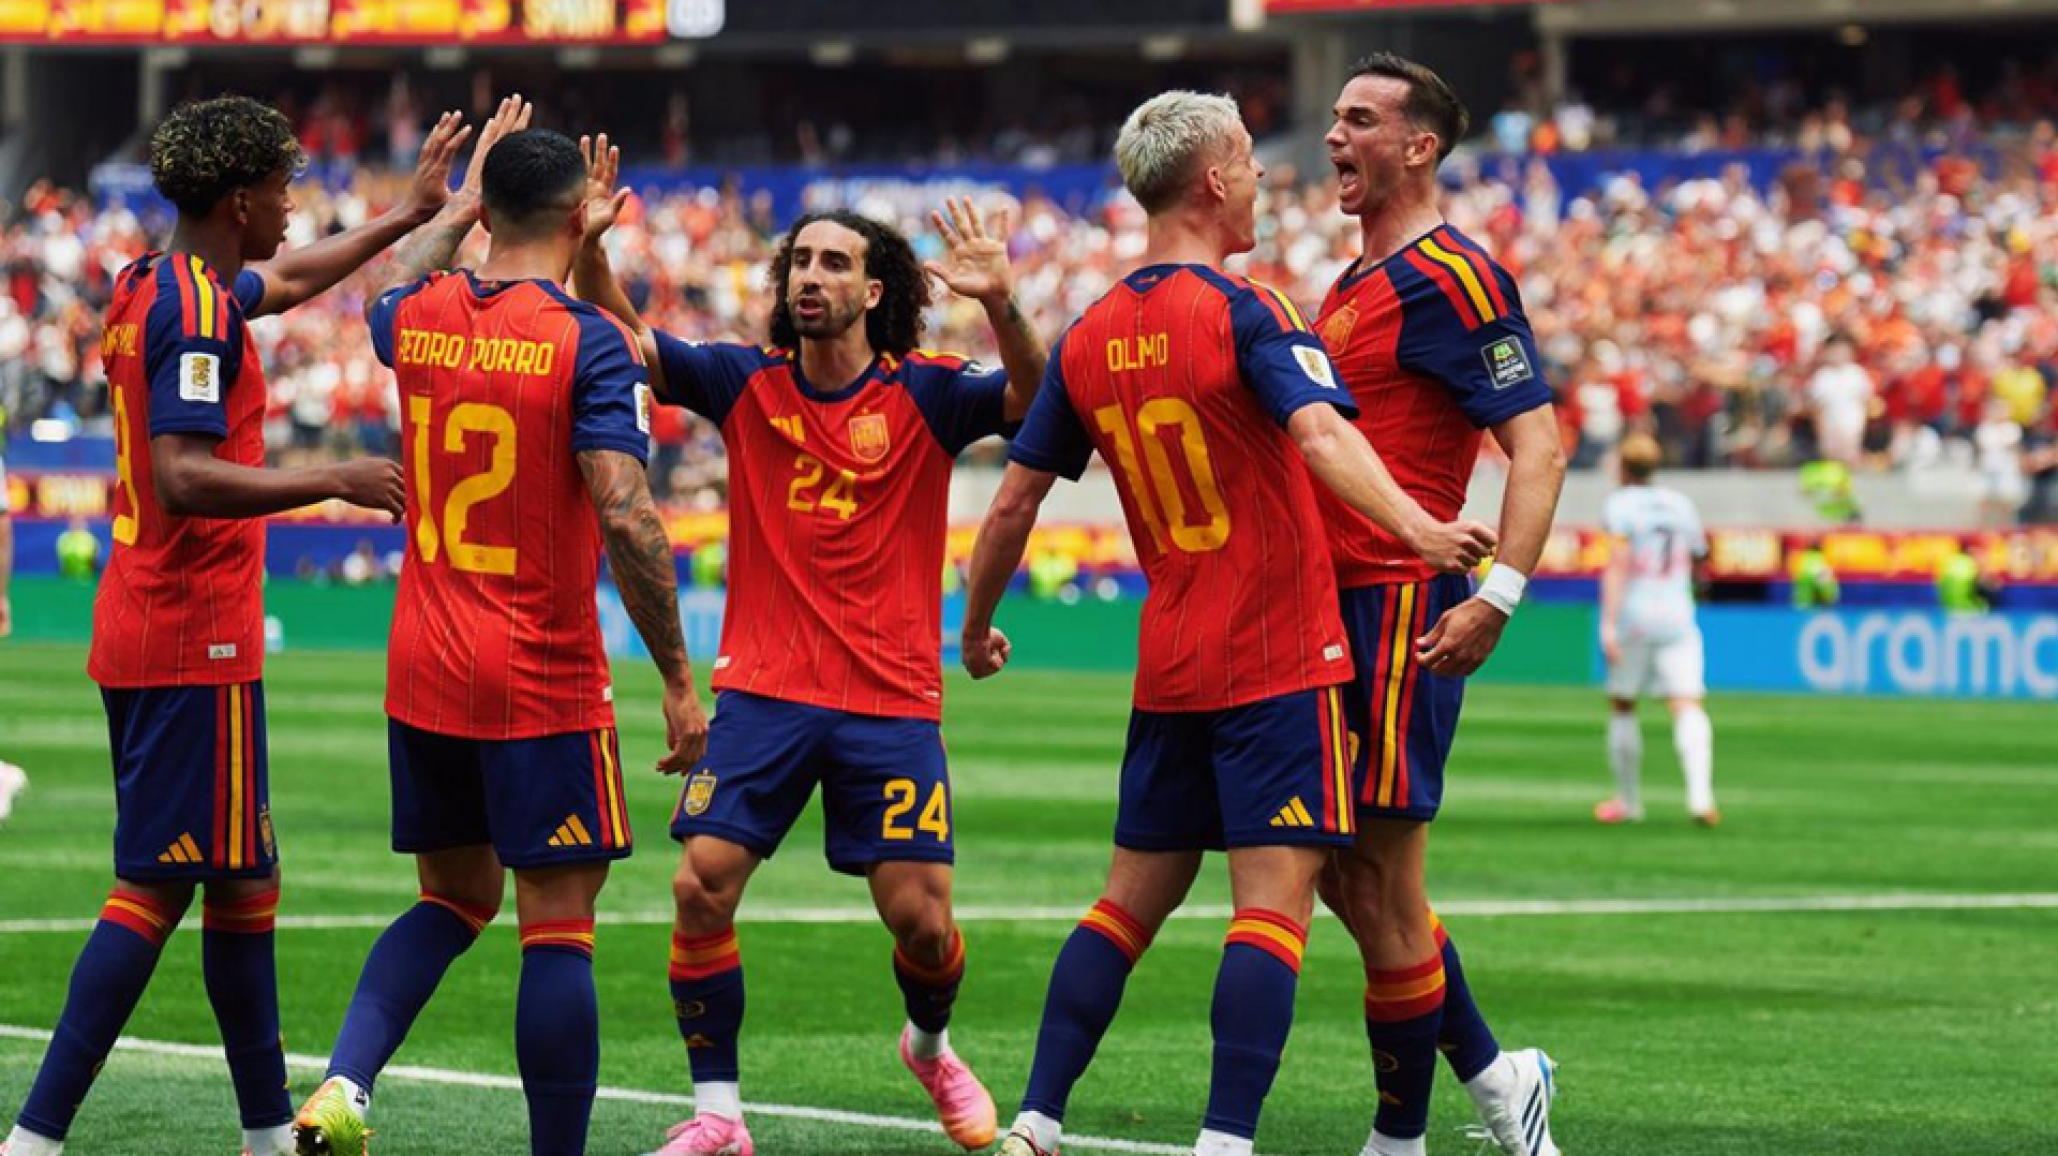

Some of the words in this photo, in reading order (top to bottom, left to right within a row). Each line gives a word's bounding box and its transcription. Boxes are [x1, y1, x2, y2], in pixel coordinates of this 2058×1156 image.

[469, 337, 555, 376] PORRO
[1107, 331, 1168, 372] OLMO
[408, 396, 518, 577] 12
[787, 453, 858, 520] 24
[1094, 396, 1231, 555] 10
[881, 777, 949, 842] 24
